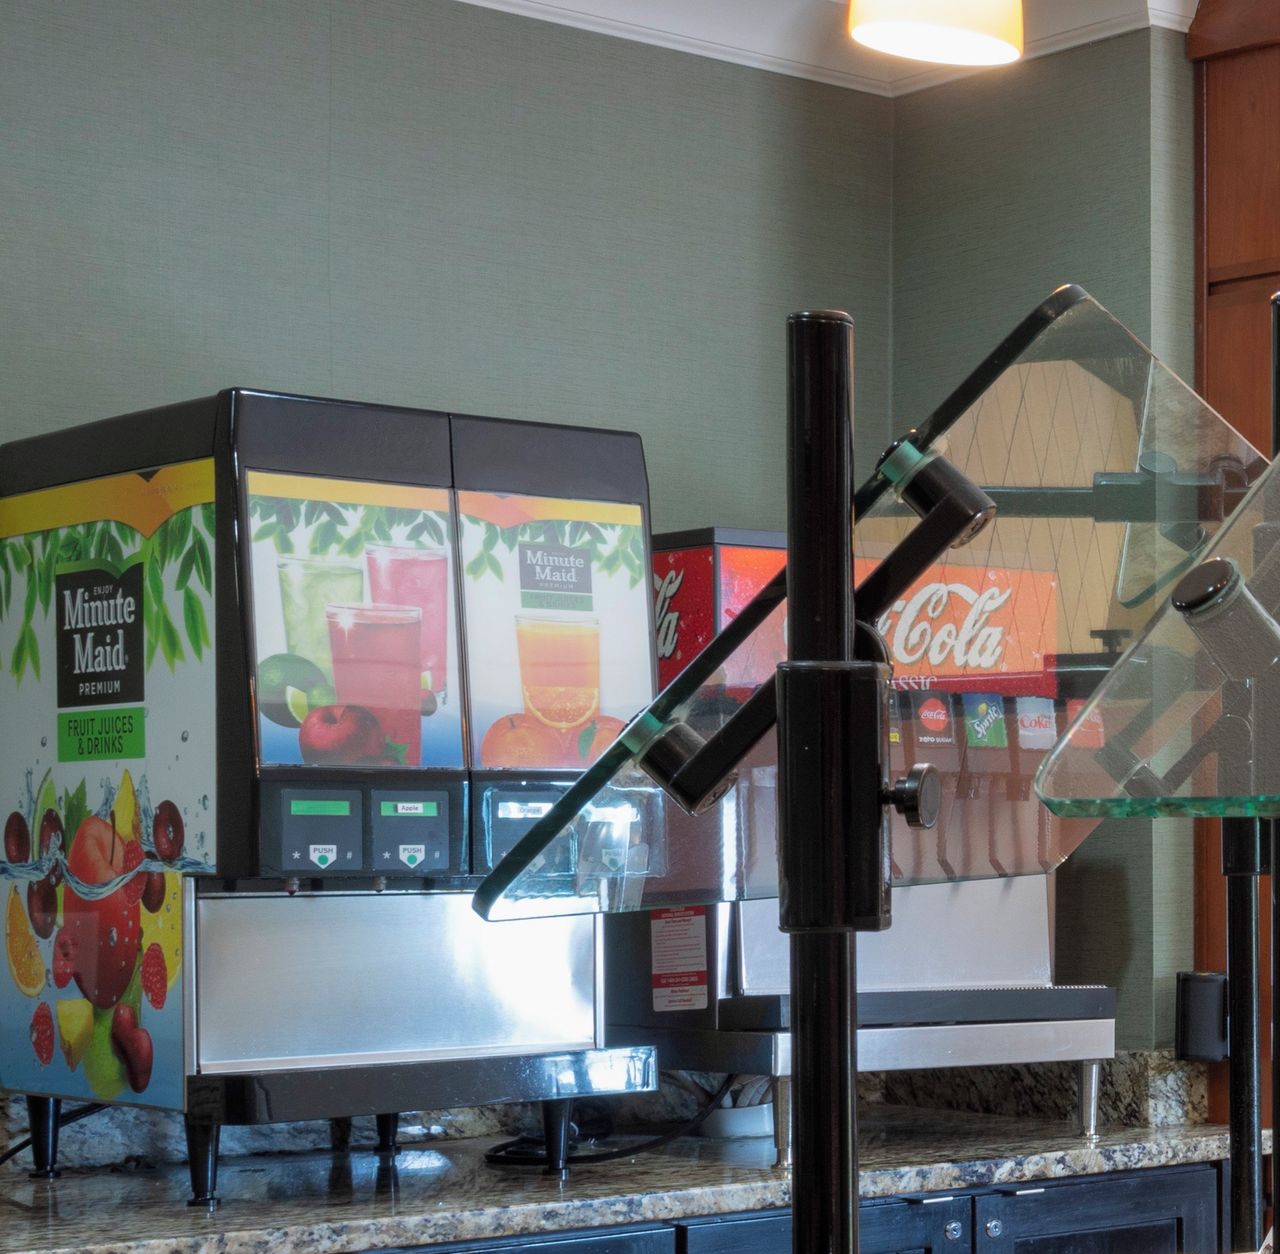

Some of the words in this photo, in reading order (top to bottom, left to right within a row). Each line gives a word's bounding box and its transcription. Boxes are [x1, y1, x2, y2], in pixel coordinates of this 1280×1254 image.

[526, 549, 585, 568] Minute
[535, 565, 578, 583] Maid
[93, 585, 113, 596] ENJOY
[63, 587, 136, 630] Minute
[73, 629, 126, 674] Maid
[79, 680, 121, 696] PREMIUM
[68, 718, 95, 737] FRUIT
[97, 715, 134, 736] JUICES
[971, 701, 1003, 739] Sprite
[78, 740, 84, 755] &
[86, 736, 123, 755] DRINKS
